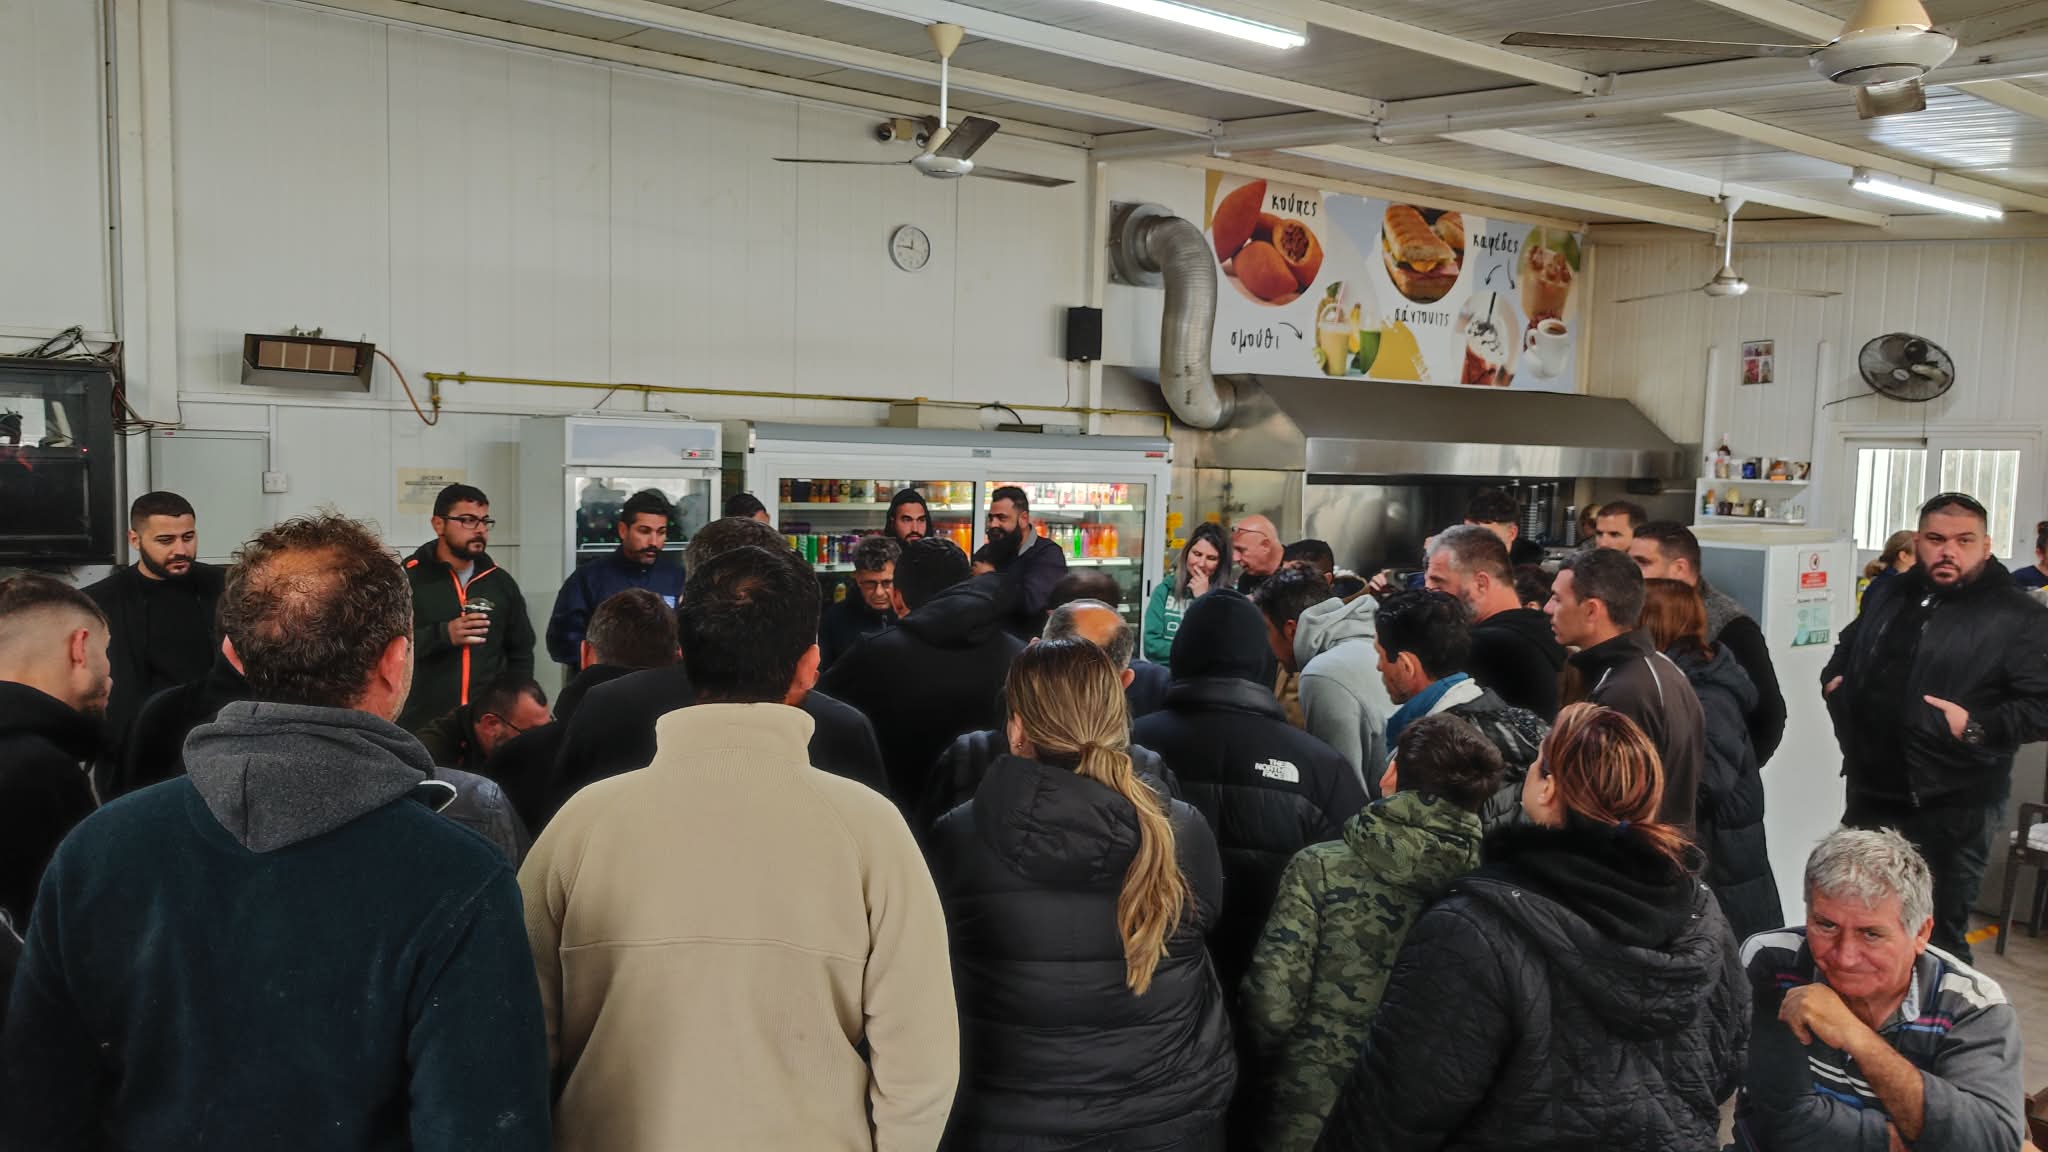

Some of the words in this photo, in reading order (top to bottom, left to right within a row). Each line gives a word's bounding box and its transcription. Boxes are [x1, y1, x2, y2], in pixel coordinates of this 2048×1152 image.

[1271, 192, 1318, 216] κούπες
[1472, 231, 1519, 257] καφέδες
[1230, 327, 1280, 354] σμούθι
